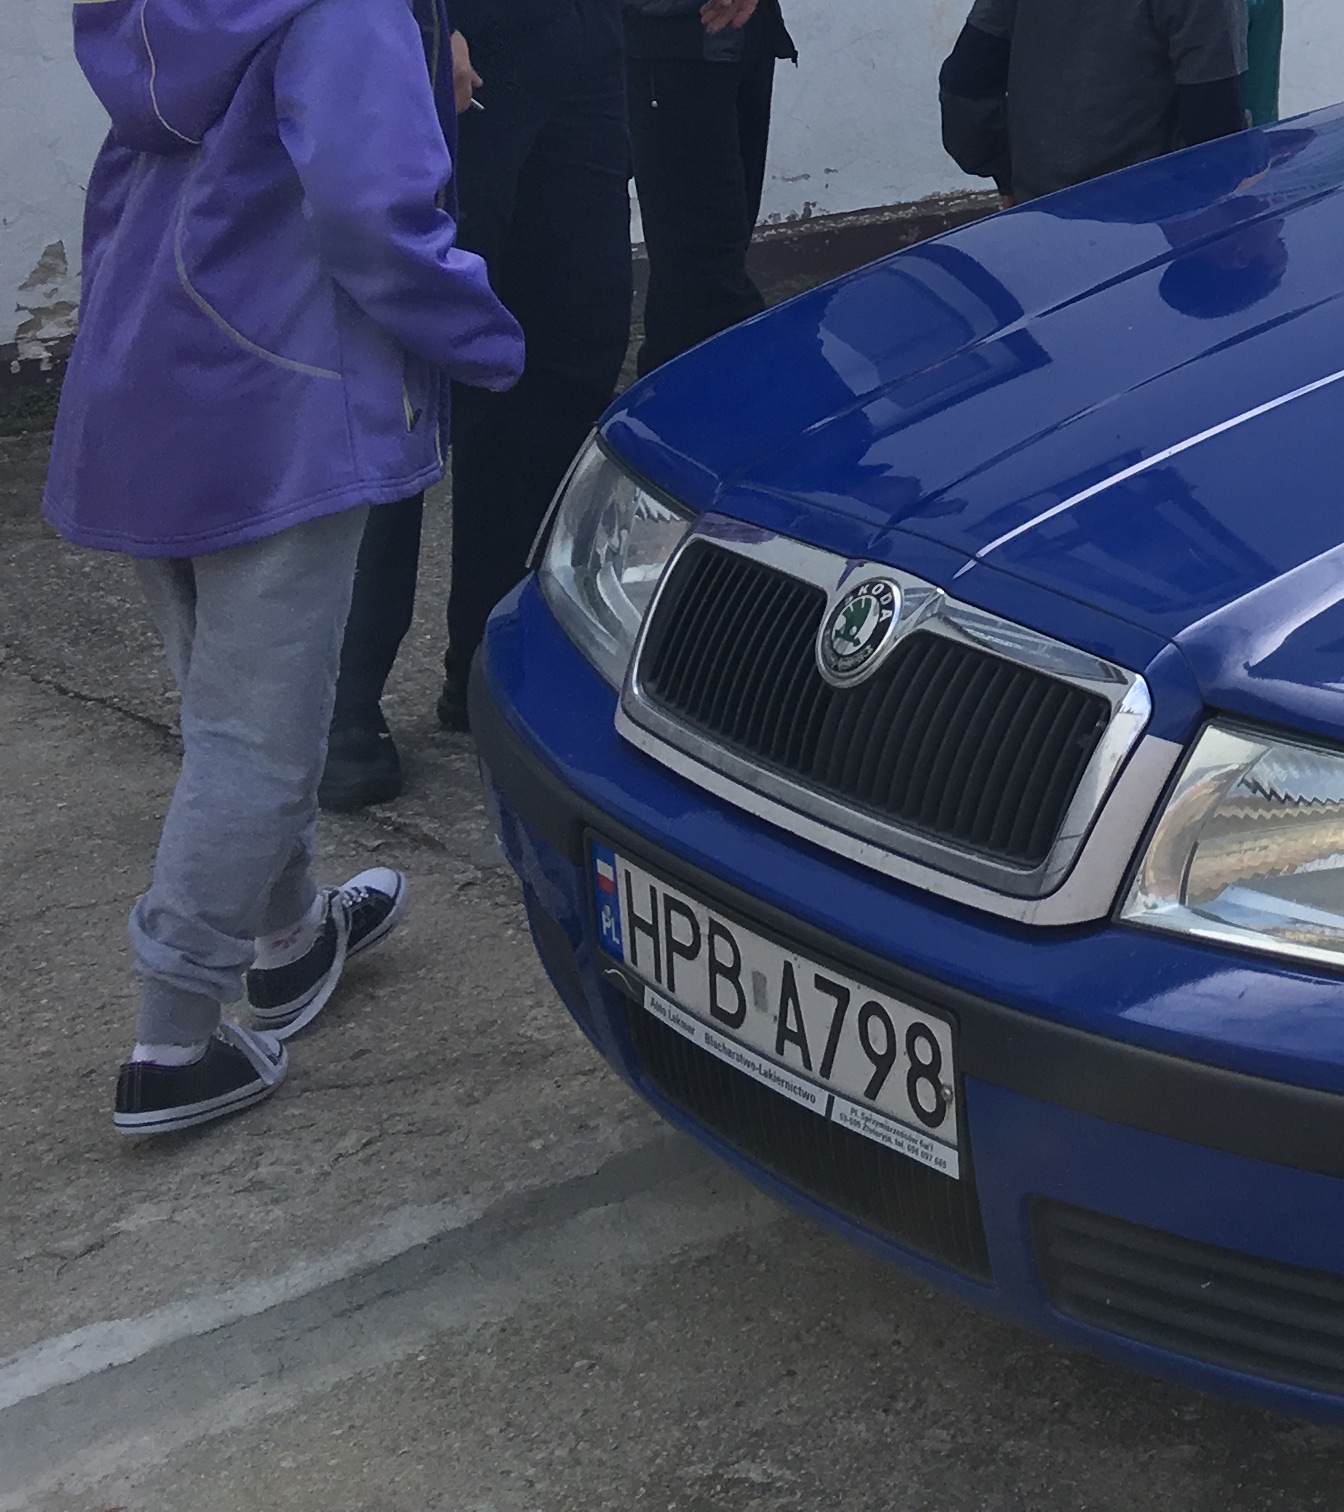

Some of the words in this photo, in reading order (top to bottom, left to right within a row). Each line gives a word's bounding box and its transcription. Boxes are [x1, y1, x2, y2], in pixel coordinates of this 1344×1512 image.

[601, 910, 621, 945] PL
[623, 868, 747, 1030] HPB
[774, 959, 948, 1129] A798
